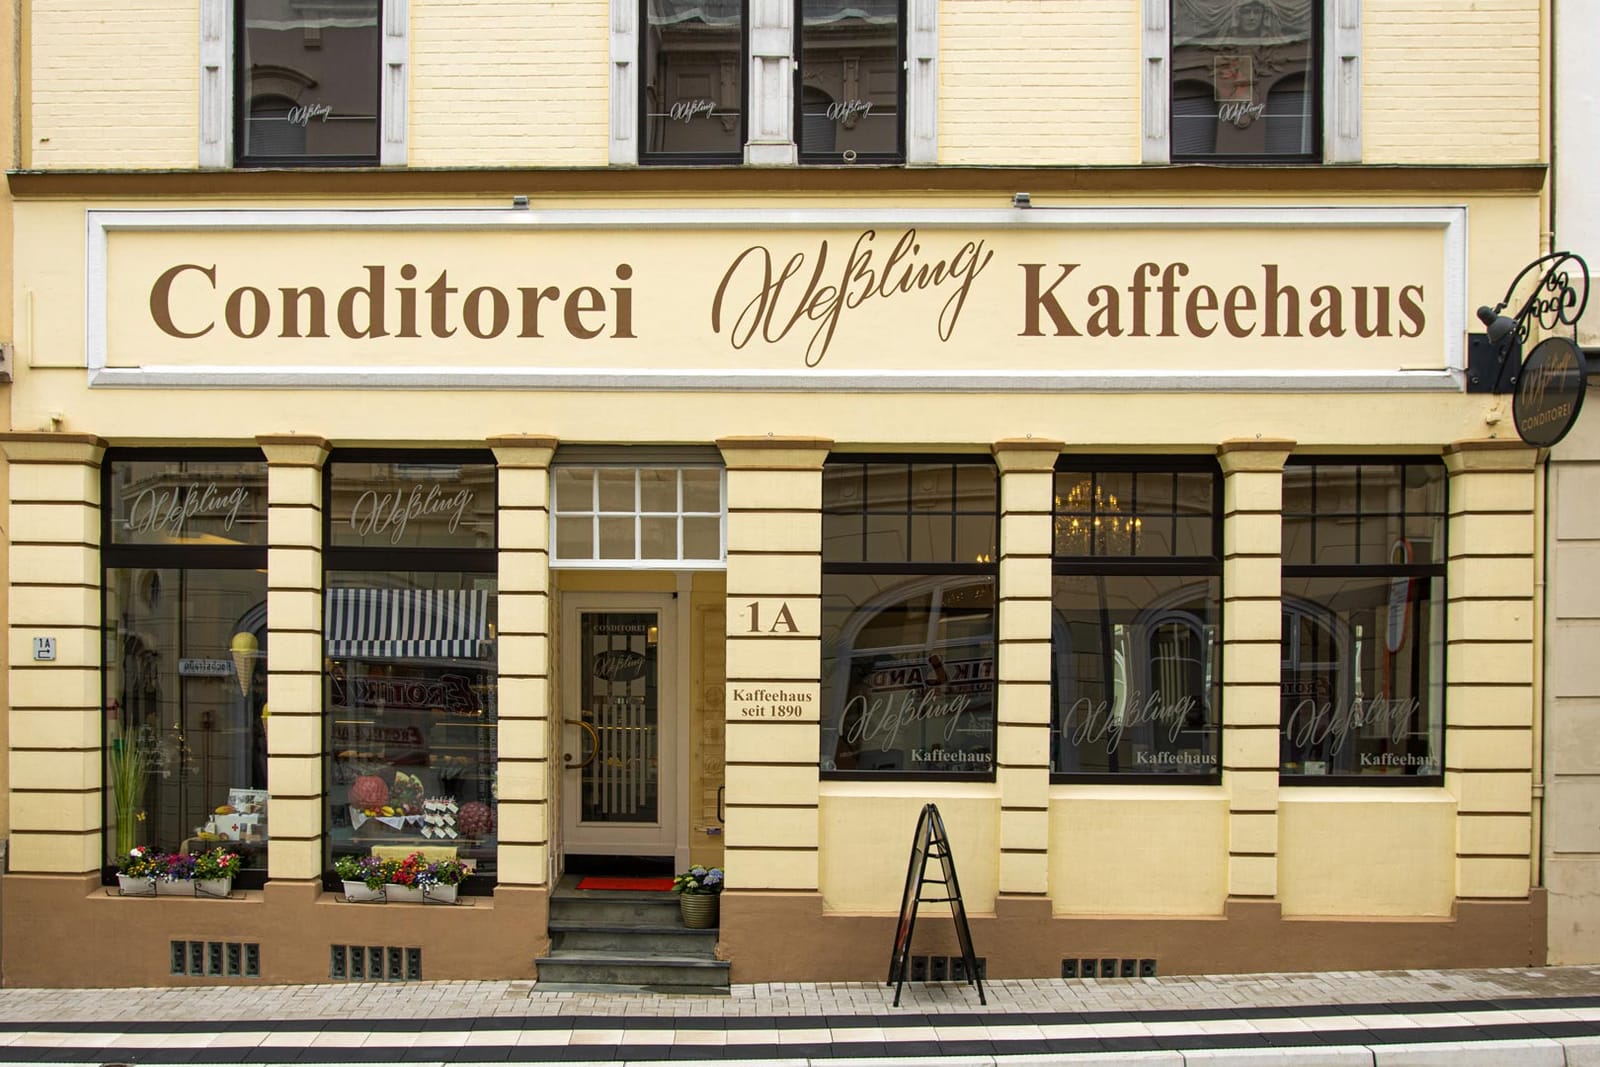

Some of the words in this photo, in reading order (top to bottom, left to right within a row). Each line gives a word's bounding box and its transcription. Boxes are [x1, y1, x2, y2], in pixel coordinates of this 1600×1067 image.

[150, 264, 638, 339] Conditorei
[713, 229, 993, 368] Weßling
[1017, 263, 1426, 338] Kaffeehaus
[1521, 402, 1572, 432] CONDITOREI
[130, 482, 249, 538] Weßling
[351, 484, 474, 544] Weßling
[746, 601, 800, 634] 1A
[39, 638, 51, 648] 1A
[733, 688, 813, 704] Kaffeehaus
[741, 705, 767, 718] seit
[770, 705, 803, 718] 1890
[839, 688, 971, 752] Weßling
[1063, 689, 1197, 755] Weßling
[911, 749, 993, 763] Kaffeehaus
[1136, 751, 1217, 765] Kaffeehaus
